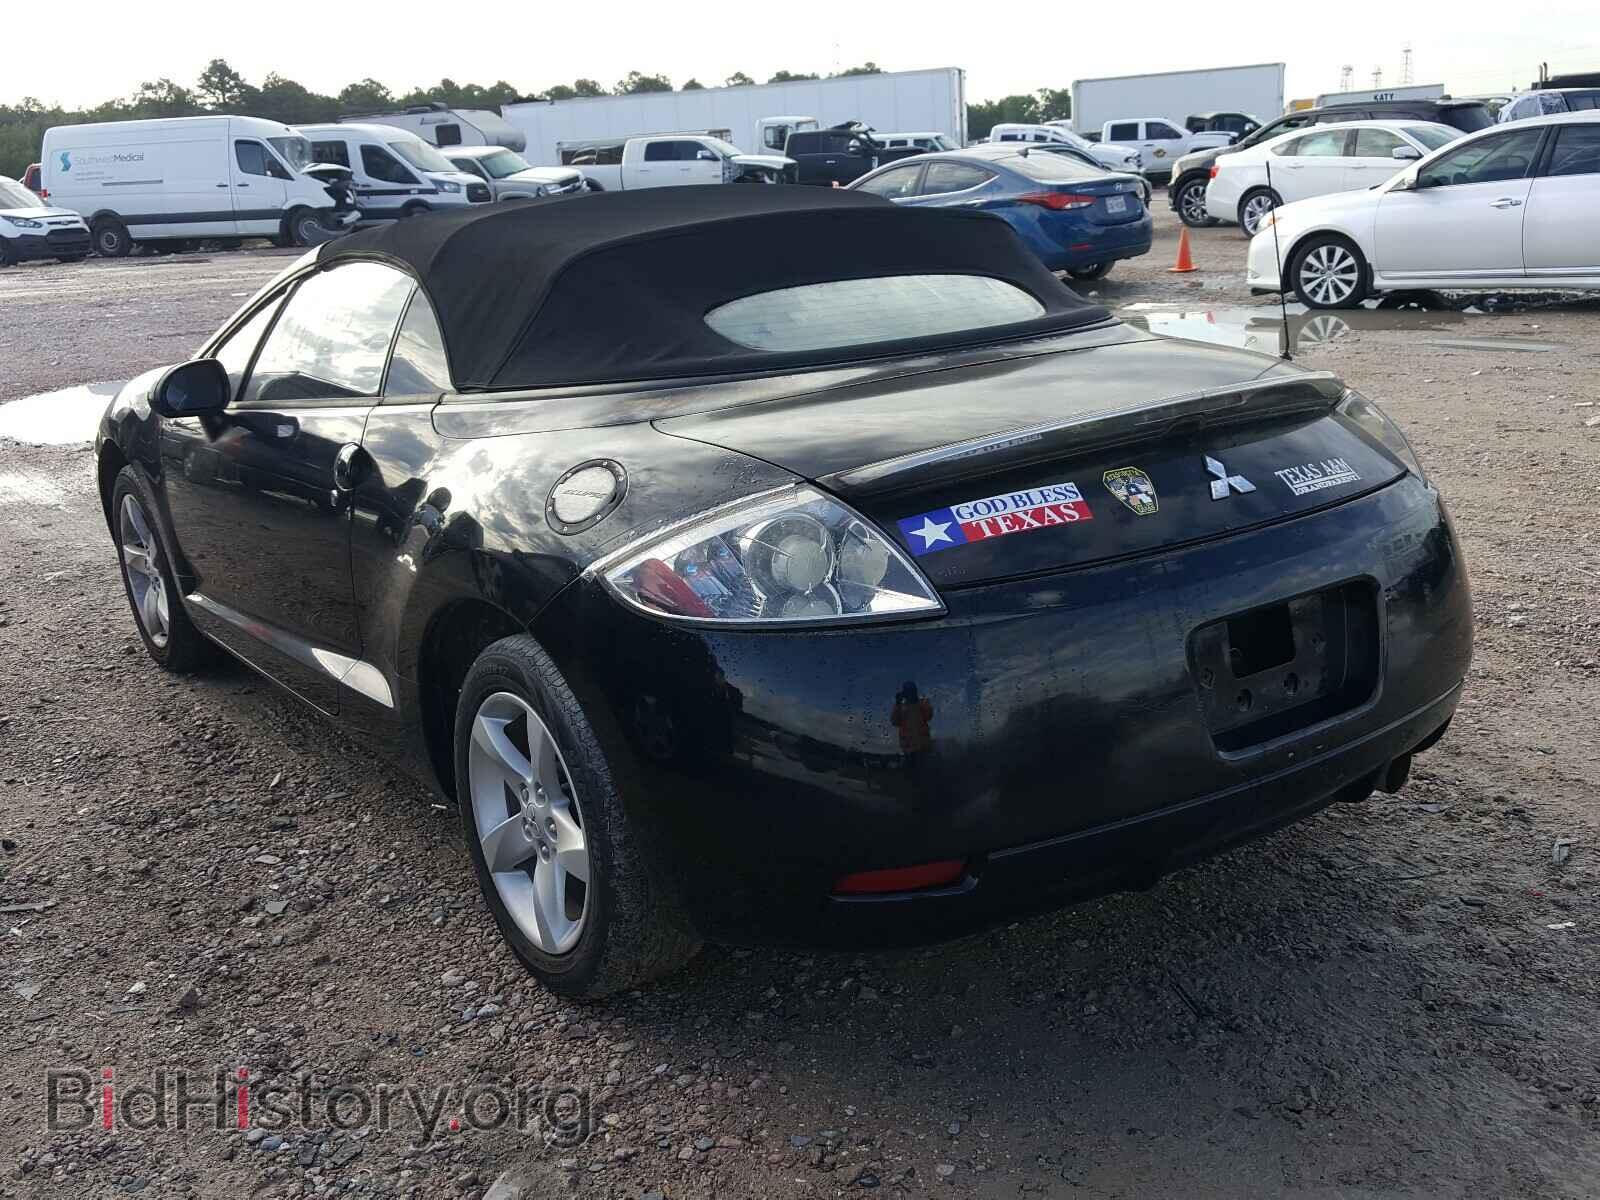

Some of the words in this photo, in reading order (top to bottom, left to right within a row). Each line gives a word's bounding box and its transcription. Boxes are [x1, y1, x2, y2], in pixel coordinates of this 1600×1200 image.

[1274, 463, 1322, 488] TEXAS
[1319, 457, 1358, 478] A&M
[955, 497, 1008, 520] GOD
[1010, 482, 1080, 509] BLESS
[971, 502, 1080, 538] TEXAS
